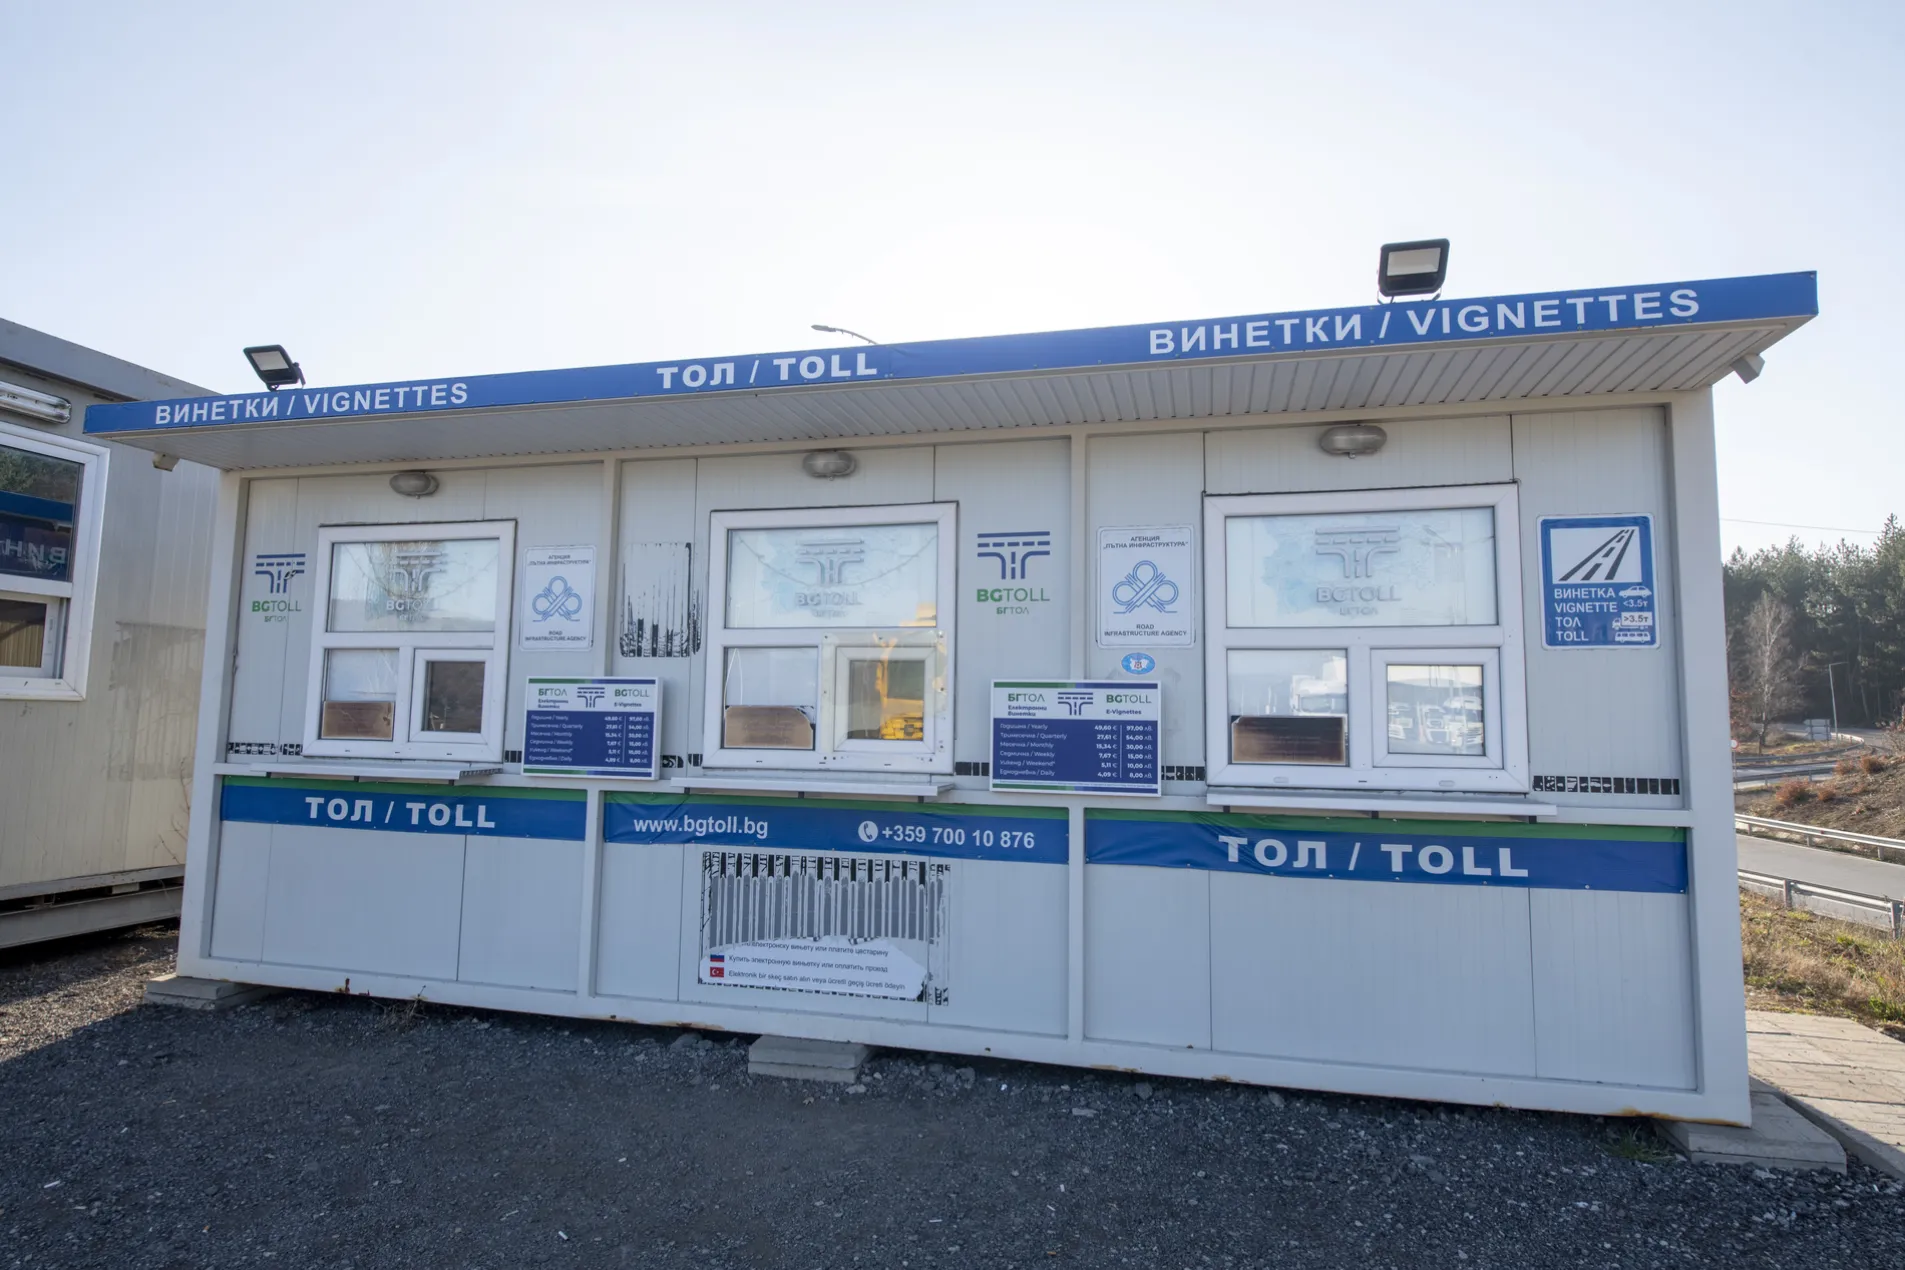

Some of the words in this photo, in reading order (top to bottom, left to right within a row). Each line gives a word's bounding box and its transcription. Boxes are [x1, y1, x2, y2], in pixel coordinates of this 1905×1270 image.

[1149, 314, 1362, 355] ВИНЕТКИ
[1378, 312, 1391, 339] /
[1406, 288, 1700, 336] VIGNETTES
[656, 362, 735, 389] ТОЛ
[749, 360, 760, 384] /
[773, 353, 878, 381] TOLL
[155, 397, 279, 425] ВИНЕТКИ
[287, 395, 296, 416] /
[303, 382, 468, 414] VIGNETTES
[976, 588, 1050, 602] BGTOLL
[1554, 587, 1616, 599] ВИНЕТКА
[252, 600, 302, 612] BGTOLL
[996, 606, 1029, 615] БГТОЛ
[1554, 602, 1618, 613] VIGNETTE
[1555, 616, 1581, 627] ТОЛ
[1556, 631, 1589, 642] TOLL
[614, 688, 650, 698] BGTOLL
[1007, 693, 1045, 702] БГТОЛ
[1106, 694, 1152, 704] BGTOLL
[305, 797, 373, 822] ТОЛ
[384, 801, 395, 824] /
[405, 802, 496, 829] TOLL
[633, 815, 768, 839] www.bgtoll.bg
[882, 826, 926, 843] +359
[931, 827, 965, 845] 700
[972, 829, 993, 847] 10
[999, 831, 1035, 849] 876
[1218, 835, 1327, 870] ТОЛ
[1347, 841, 1361, 871] /
[1380, 843, 1529, 878] TOLL
[728, 955, 750, 963] Купить
[751, 957, 791, 966] электронную
[834, 963, 864, 971] оплатить
[865, 965, 888, 973] проезд
[728, 970, 757, 978] Elektronik
[812, 977, 827, 985] veya
